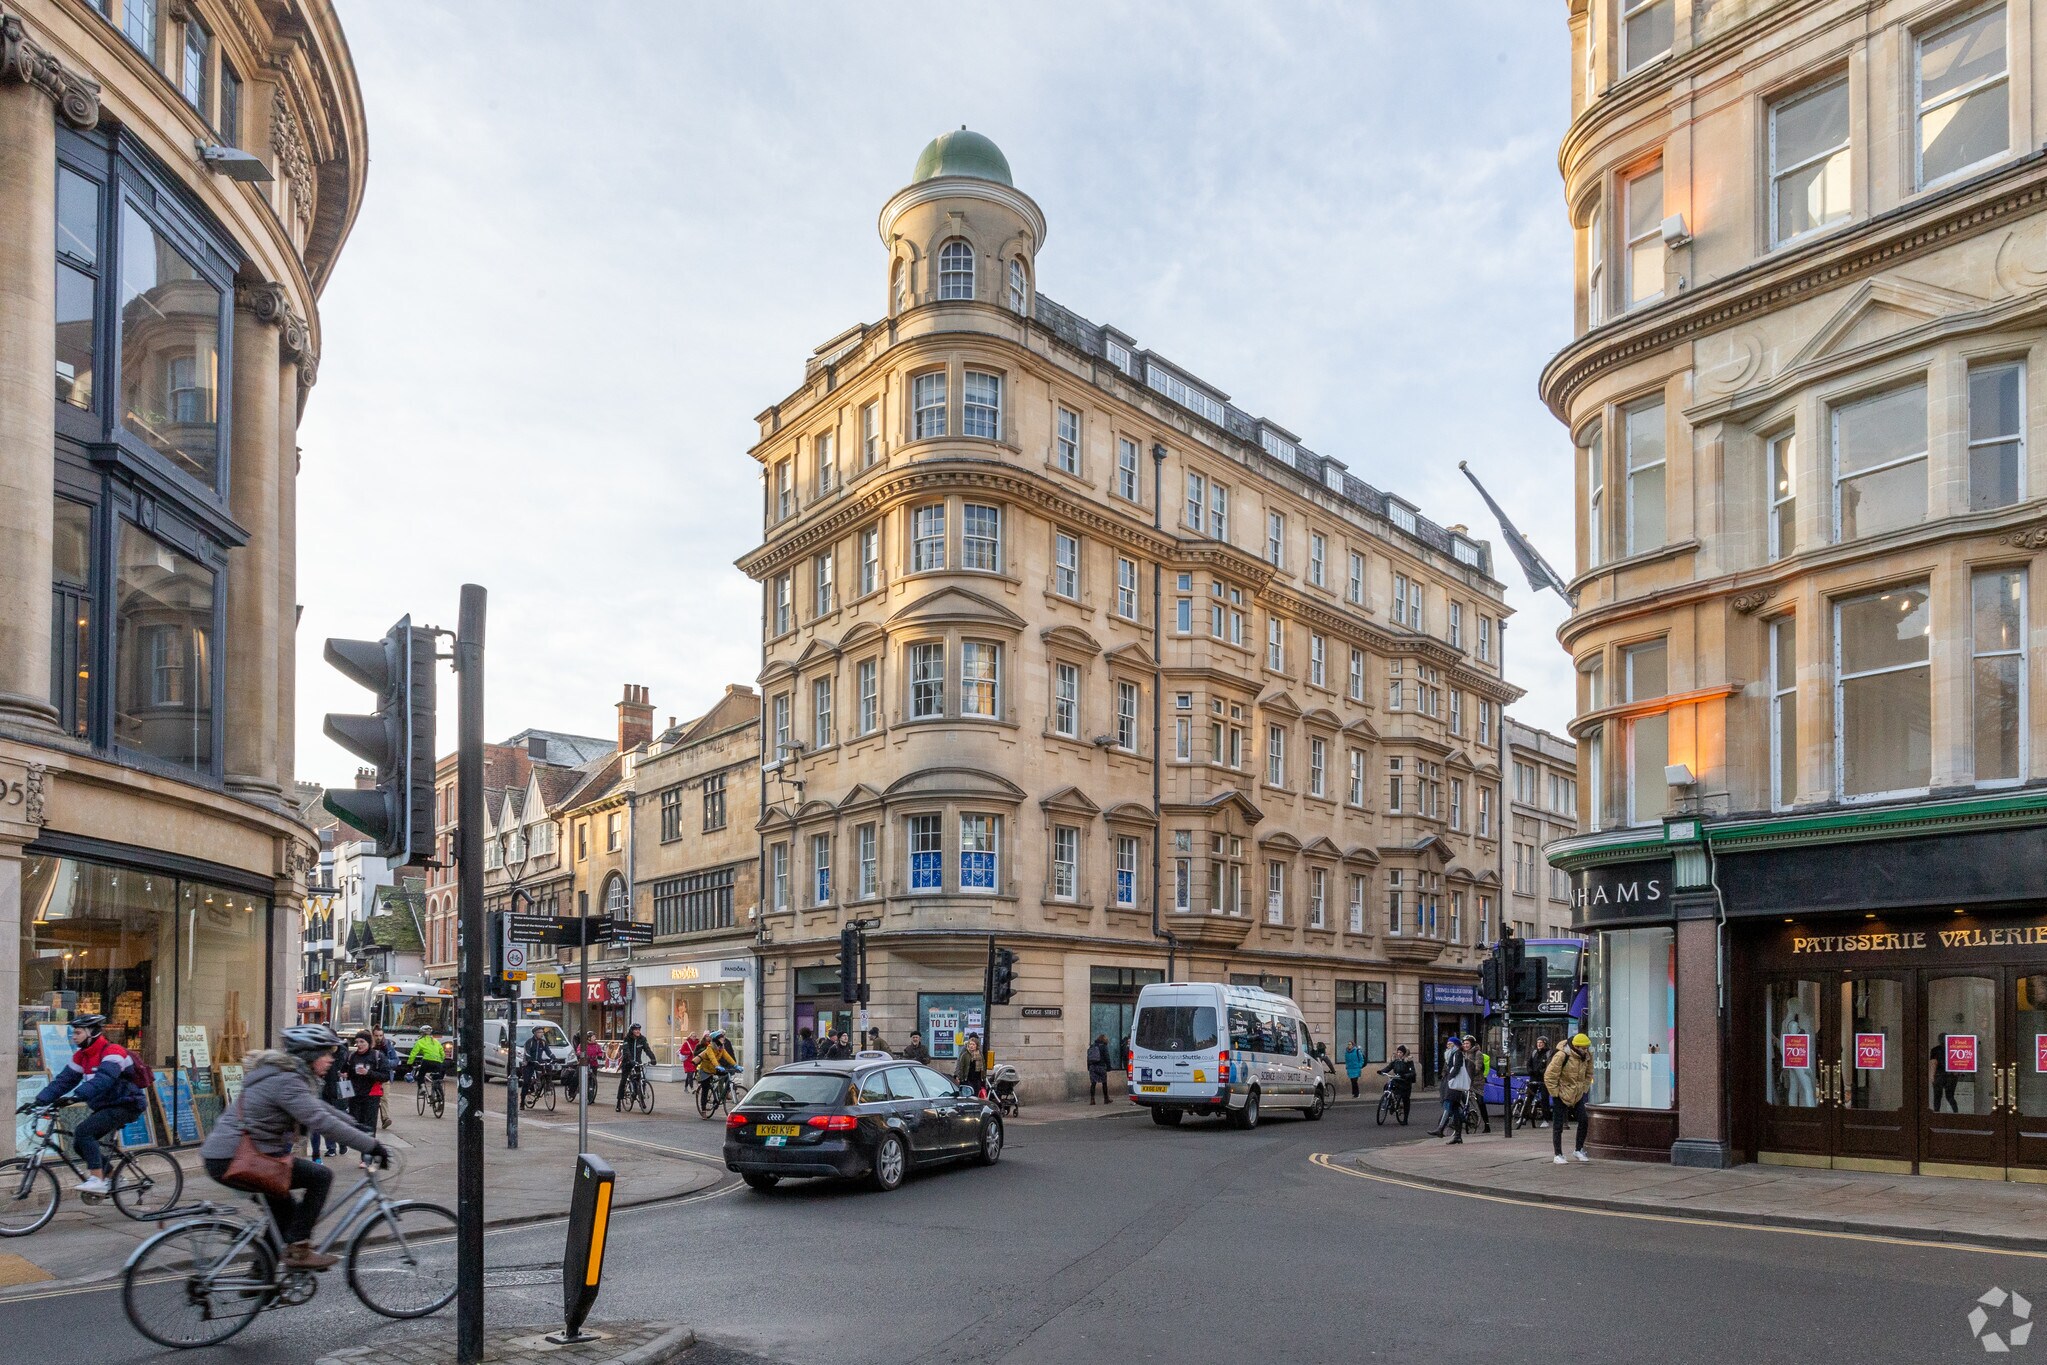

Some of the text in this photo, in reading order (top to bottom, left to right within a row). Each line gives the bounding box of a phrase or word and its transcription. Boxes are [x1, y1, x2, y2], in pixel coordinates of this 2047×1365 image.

[302, 895, 334, 923] W
[1793, 932, 1927, 954] PATISSERIE
[539, 979, 556, 989] itsu
[931, 1020, 958, 1028] TO LET
[1786, 1047, 1806, 1057] 70%
[1860, 1047, 1881, 1057] 70%
[1949, 1049, 1973, 1059] 70%
[760, 1125, 778, 1135] KY61
